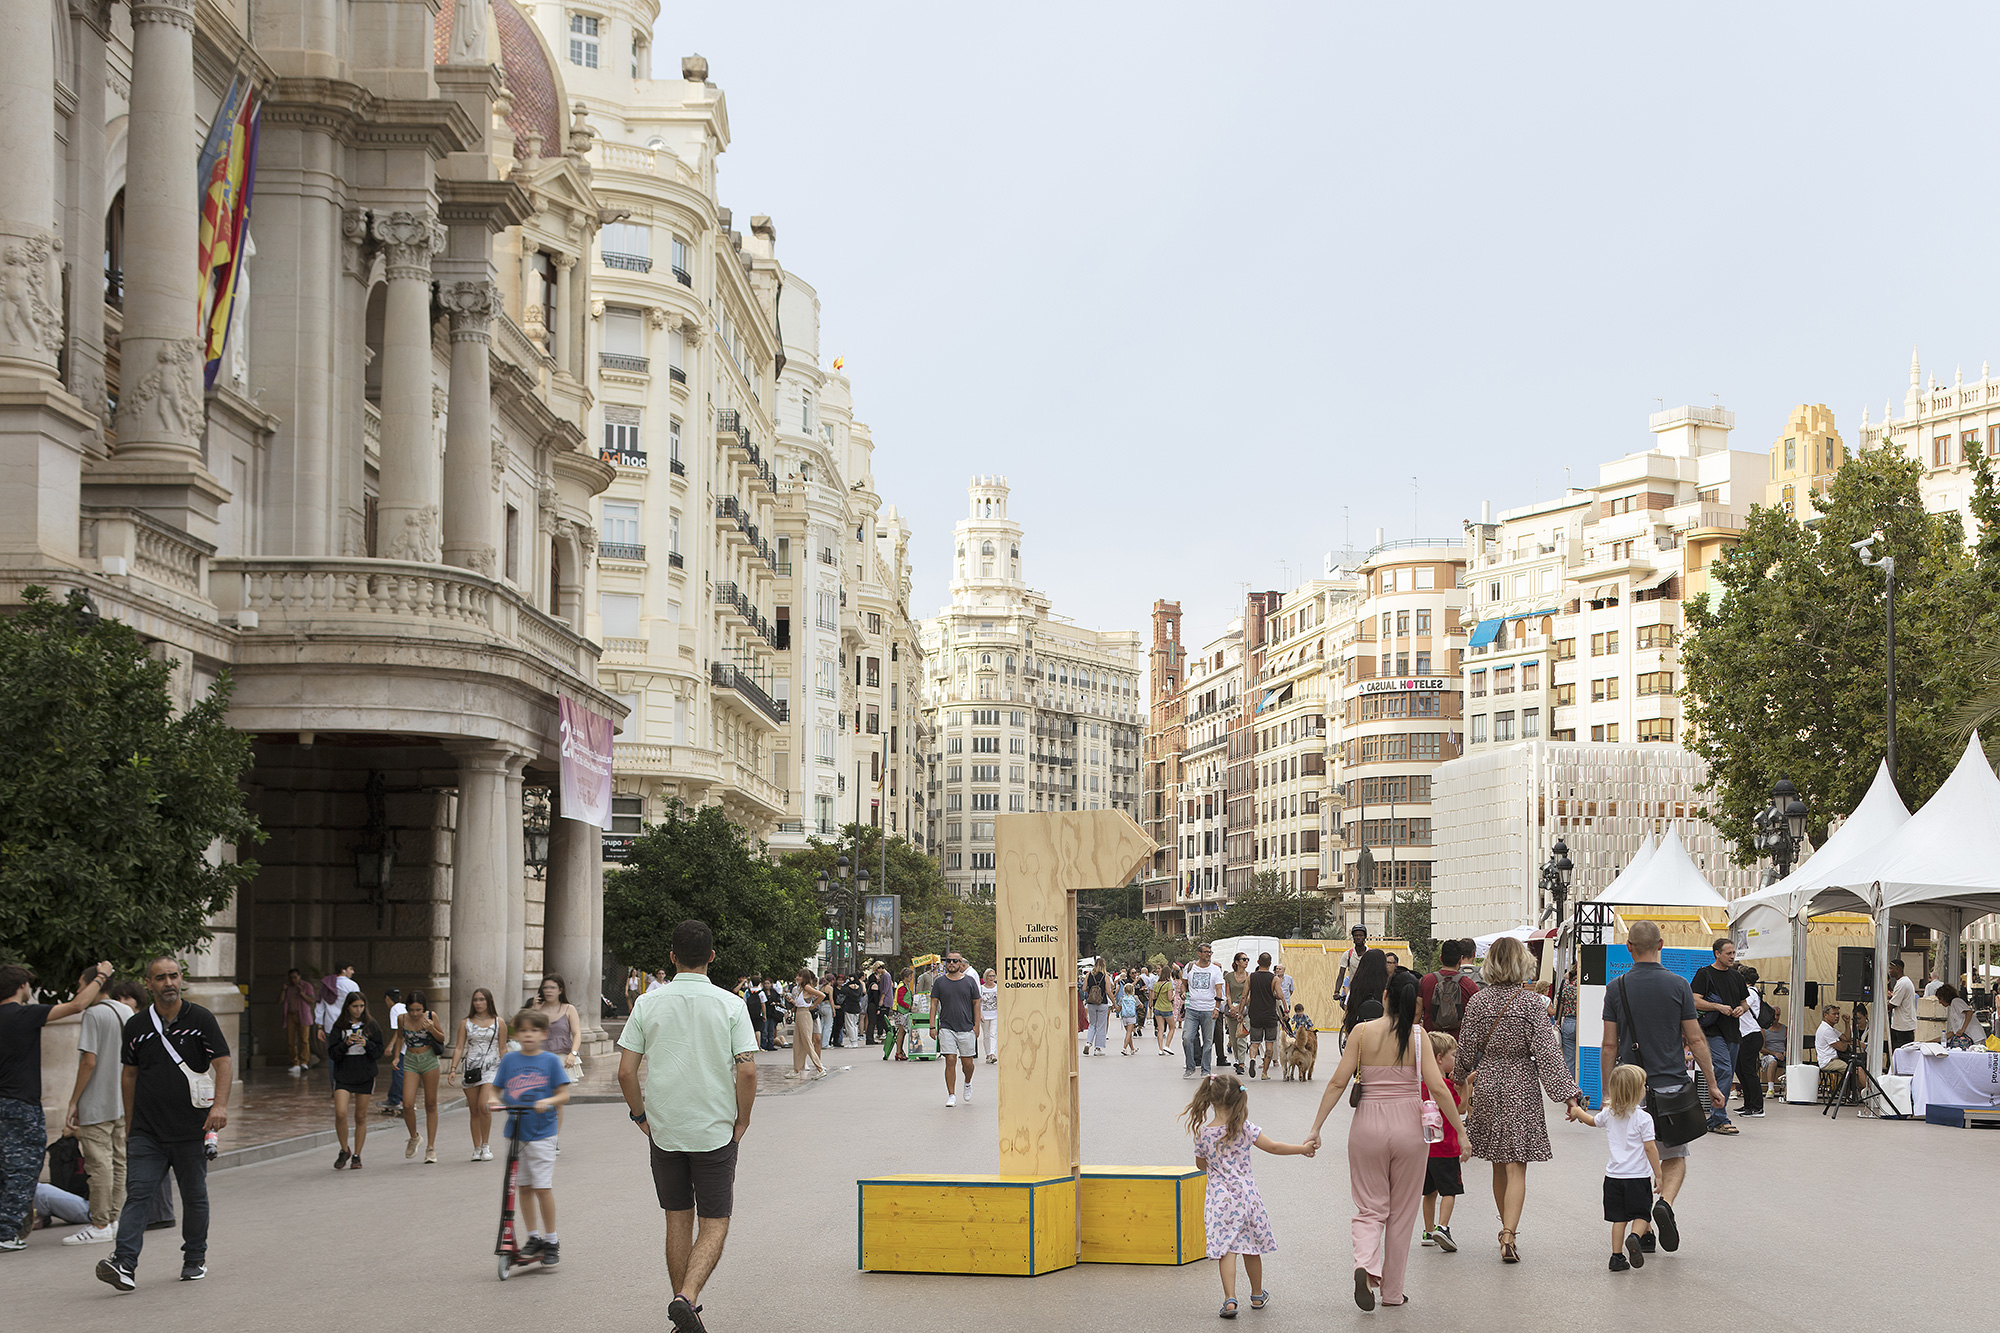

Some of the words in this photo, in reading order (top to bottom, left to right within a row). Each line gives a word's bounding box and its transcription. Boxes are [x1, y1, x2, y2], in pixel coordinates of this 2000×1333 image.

[601, 451, 646, 468] Adhoc
[1367, 681, 1397, 692] CASUAL
[1400, 679, 1443, 689] HOTELES
[601, 839, 622, 847] Grupo
[1026, 924, 1058, 932] Talleres
[1019, 934, 1058, 943] infantiles
[1005, 957, 1058, 980] FESTIVAL
